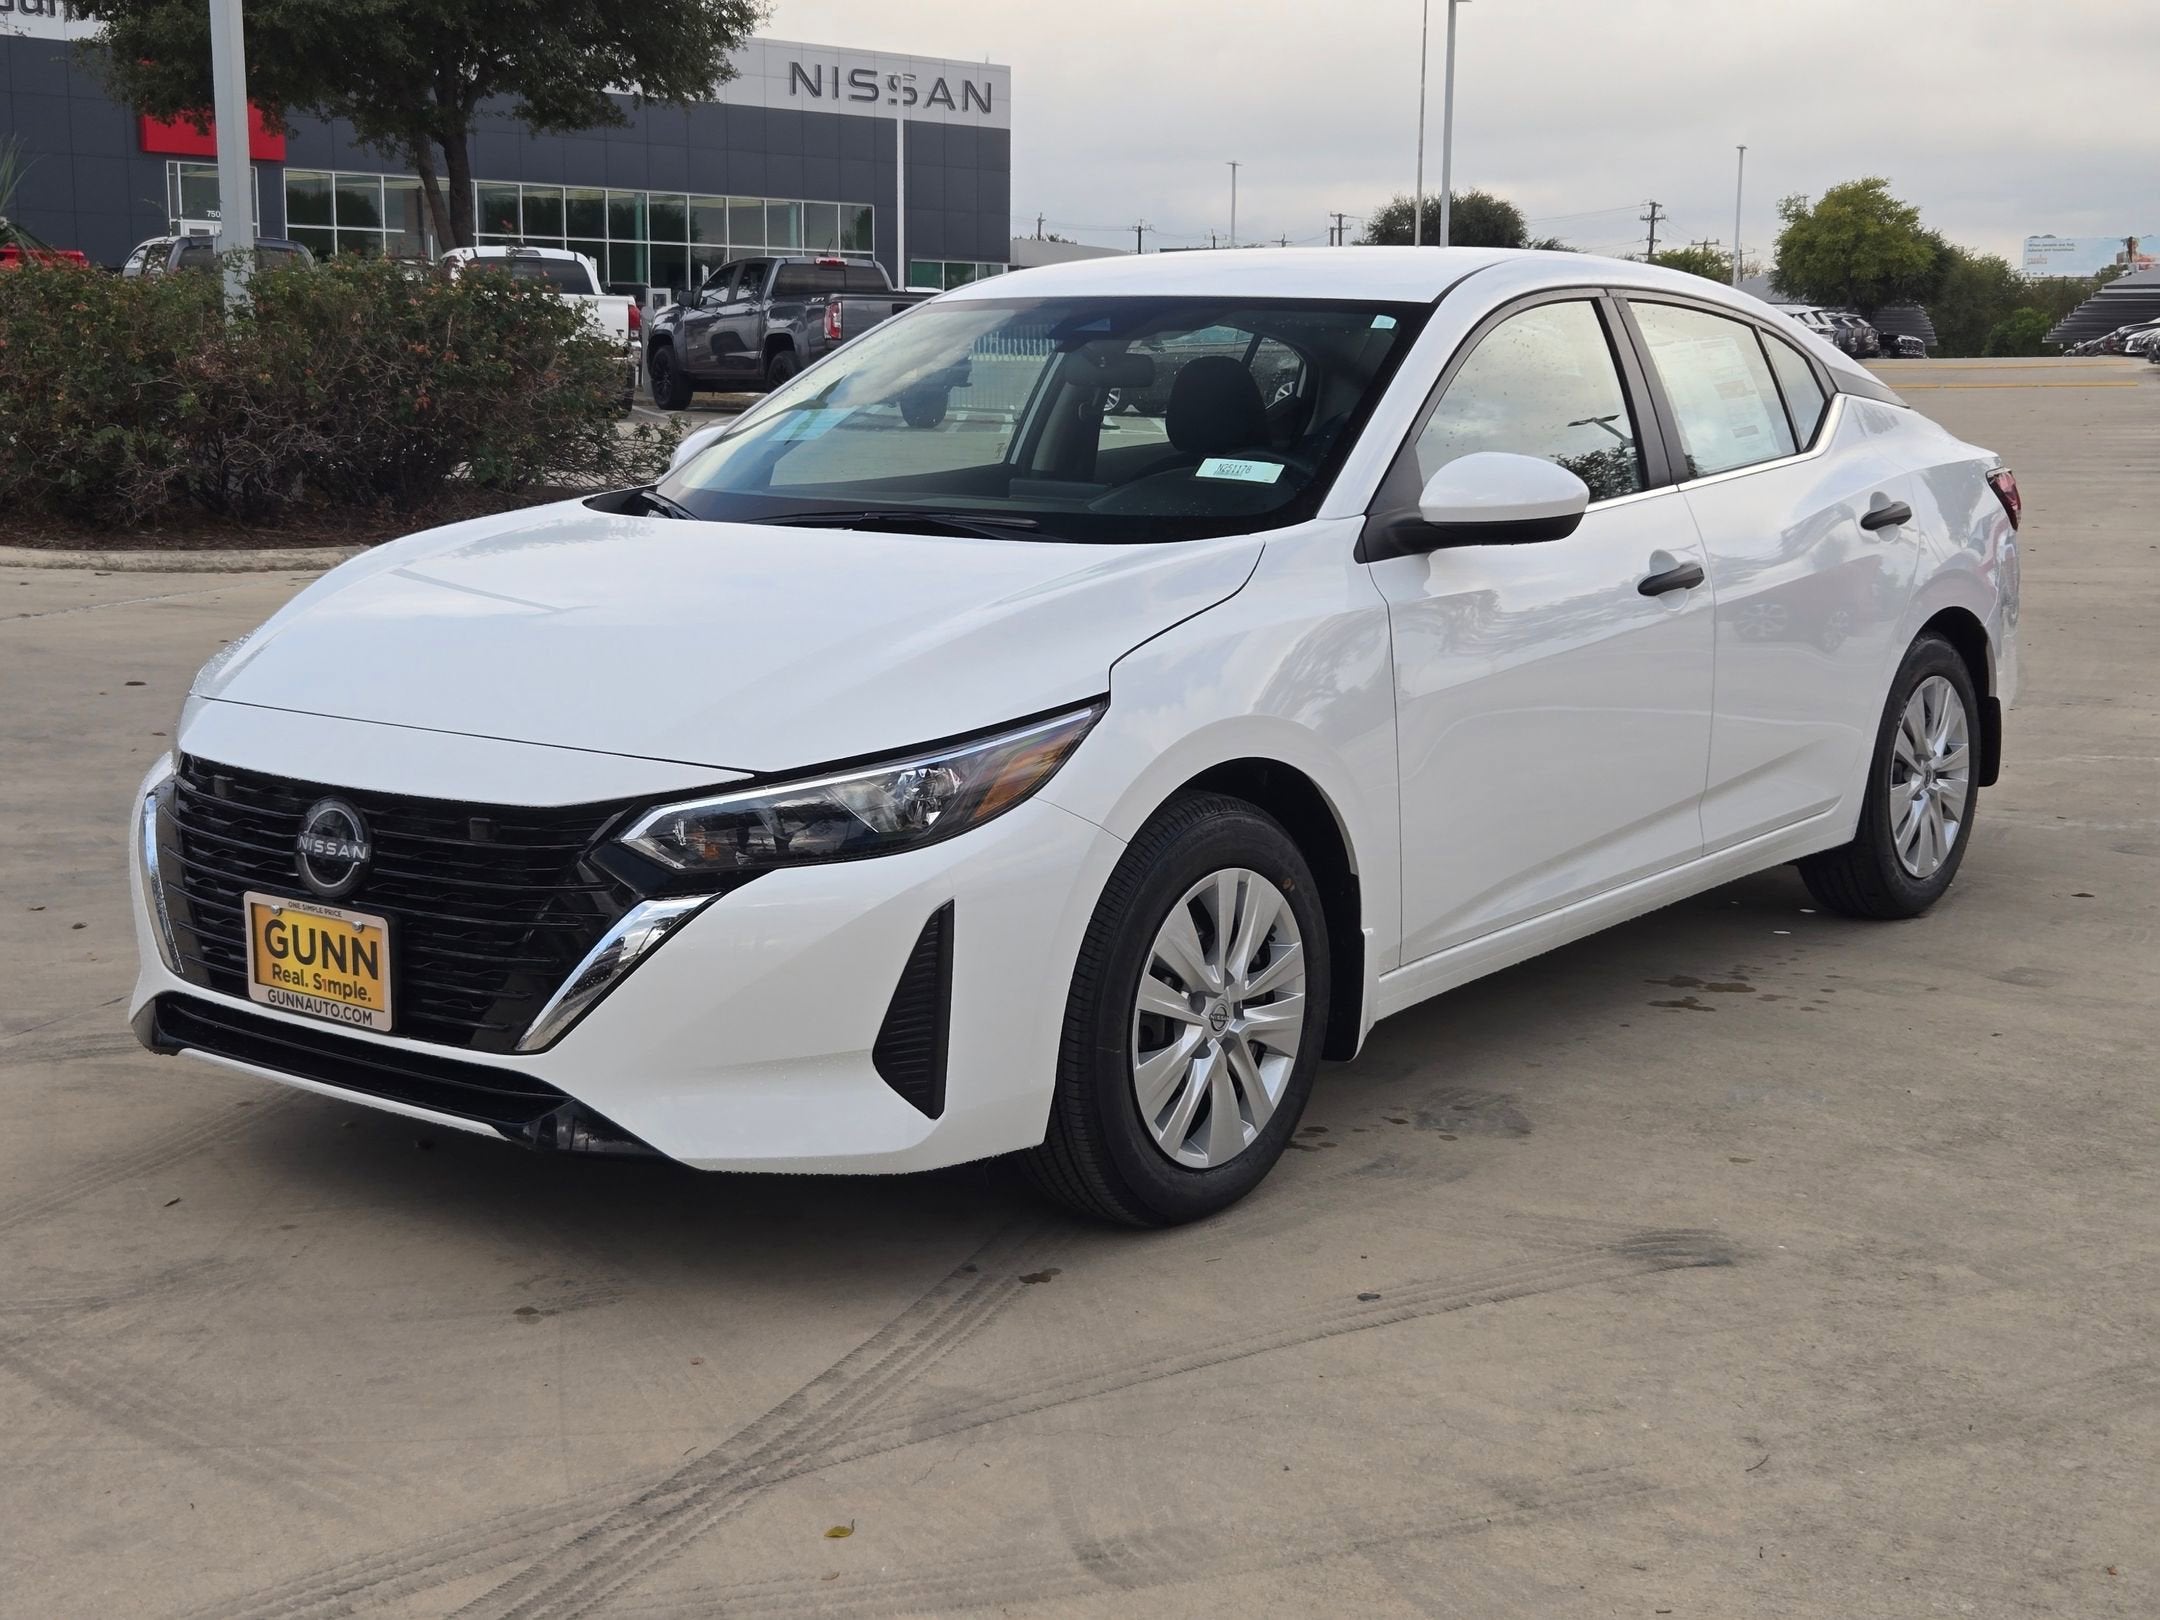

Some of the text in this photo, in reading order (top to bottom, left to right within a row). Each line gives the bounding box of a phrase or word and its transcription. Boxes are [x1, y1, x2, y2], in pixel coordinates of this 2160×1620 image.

[790, 61, 992, 115] NISSAN
[298, 836, 367, 859] NISSAN
[288, 901, 343, 917] ONE SIMPLE PRICE
[264, 919, 379, 980] GUNN
[272, 963, 309, 988] Real.
[267, 988, 373, 1025] GUNNAUTO.COM
